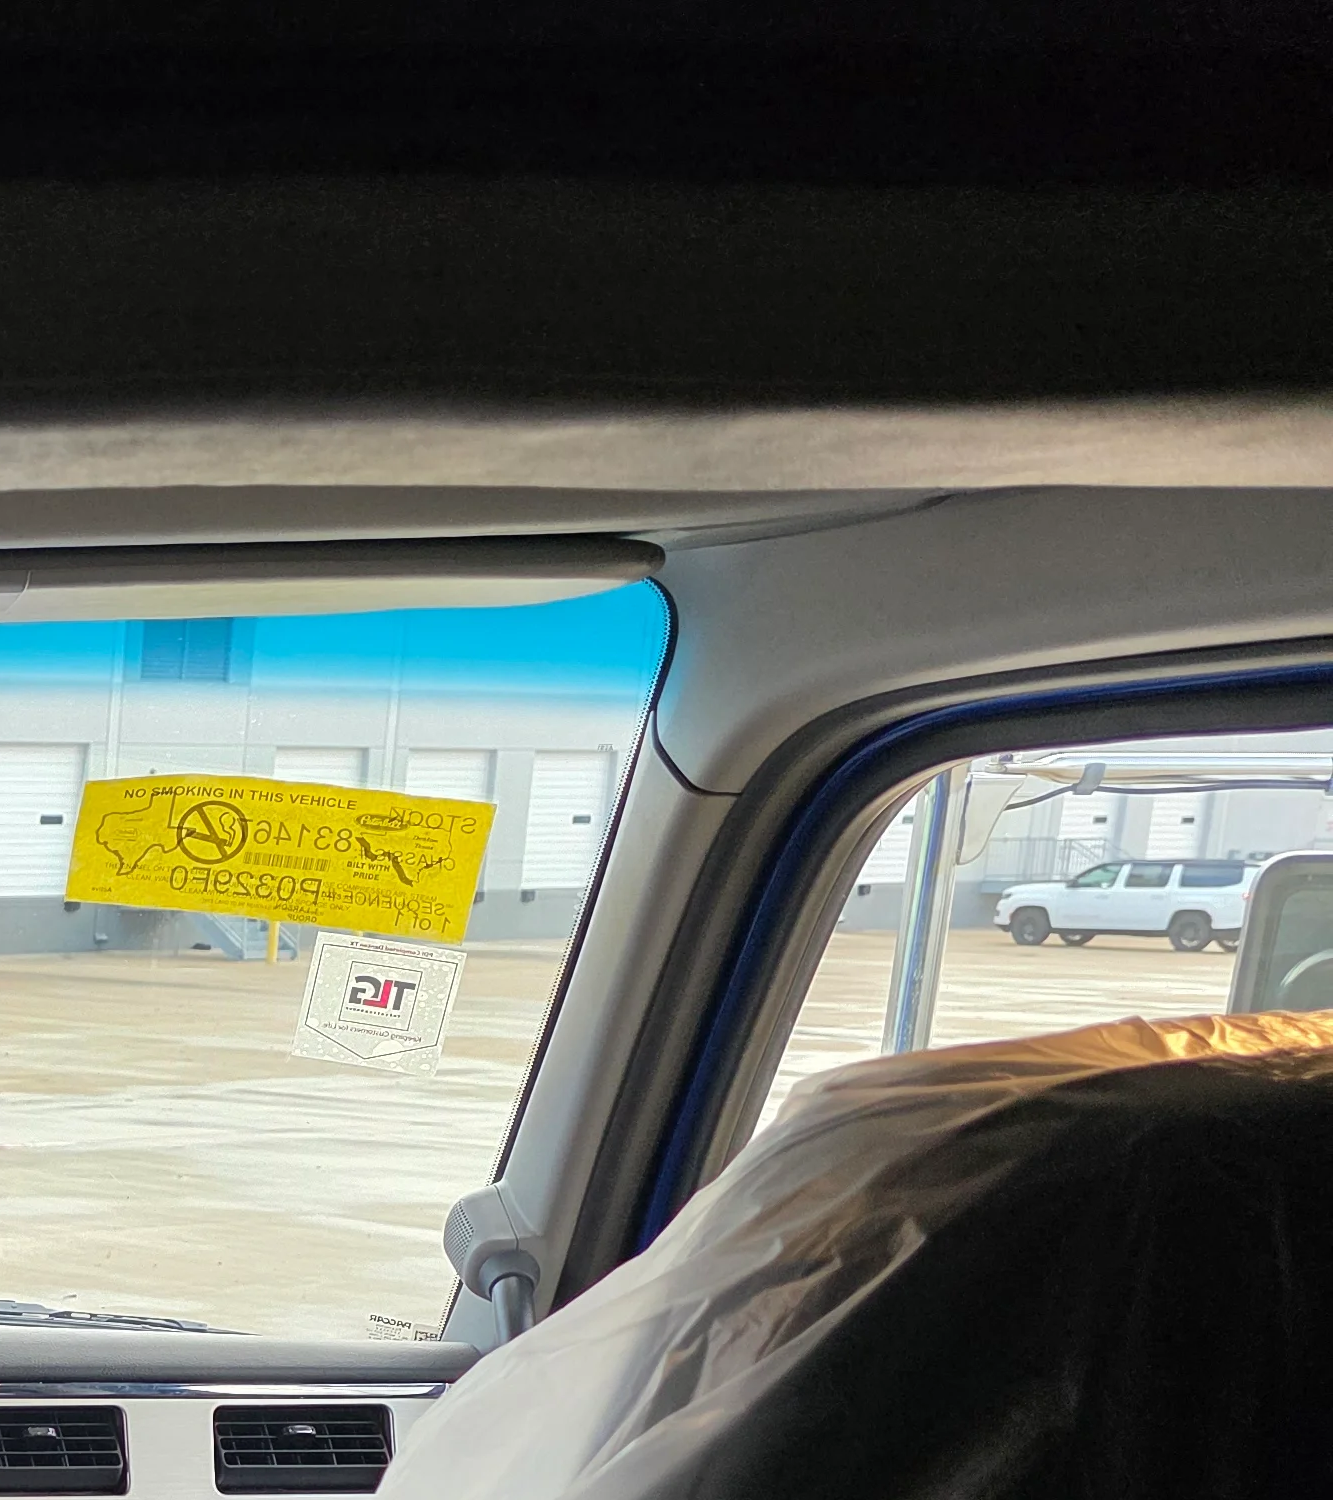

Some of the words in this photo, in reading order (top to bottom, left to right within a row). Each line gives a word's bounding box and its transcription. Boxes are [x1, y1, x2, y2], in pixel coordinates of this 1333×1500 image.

[124, 788, 146, 799] NO
[151, 786, 225, 798] SMOKING
[228, 788, 245, 800] IN
[250, 789, 284, 803] THIS
[290, 793, 358, 810] VEHICLE
[353, 871, 380, 881] PRIDE
